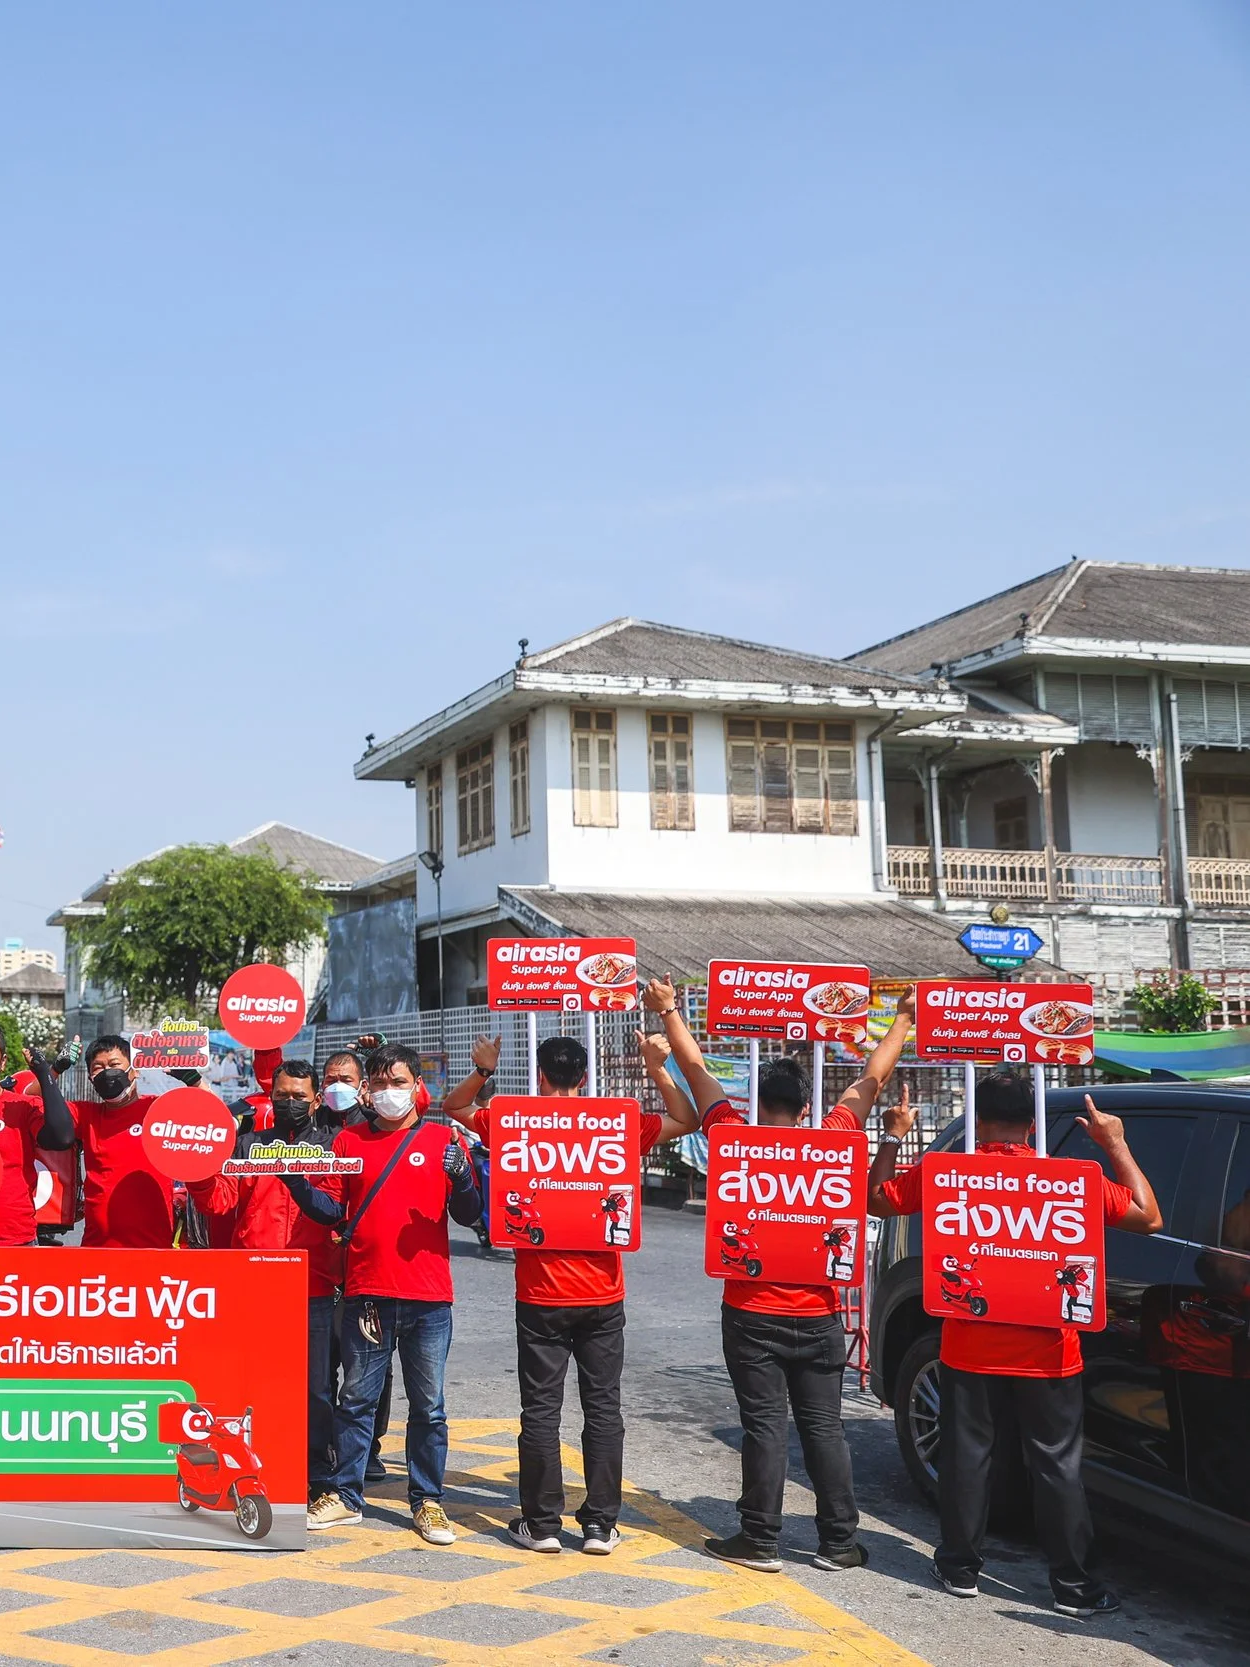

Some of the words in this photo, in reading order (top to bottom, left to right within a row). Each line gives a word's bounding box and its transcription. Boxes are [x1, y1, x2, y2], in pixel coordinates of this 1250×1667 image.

[1014, 933, 1029, 950] 21
[496, 943, 581, 962] airasia
[512, 964, 543, 975] Super
[544, 965, 567, 975] App
[719, 967, 810, 988] airasia
[502, 980, 524, 991] อิ่มคุ้ม
[553, 981, 577, 990] สั่งเลย
[227, 994, 298, 1012] airasia
[733, 989, 767, 1000] Super
[768, 991, 793, 1003] App
[927, 987, 1026, 1008] airasia
[239, 1012, 265, 1023] Super
[266, 1014, 286, 1024] App
[722, 1005, 746, 1017] อิ่มคุ้ม
[777, 1008, 803, 1018] สั่งเลย
[943, 1010, 980, 1021] Super
[982, 1011, 1009, 1023] App
[132, 1030, 208, 1048] ติดใจอาหาร
[932, 1027, 958, 1040] อิ่มคุ้ม
[992, 1029, 1021, 1040] สั่งเลย
[133, 1050, 208, 1068] ติดใจคนส่ง
[500, 1111, 572, 1129] airasia
[577, 1112, 625, 1130] food
[150, 1120, 227, 1142] airasia
[162, 1140, 190, 1151] Super
[192, 1143, 213, 1154] App
[500, 1131, 625, 1174] ส่งฟรี
[719, 1140, 795, 1160] airasia
[801, 1144, 853, 1164] food
[288, 1161, 330, 1172] airasia
[332, 1160, 361, 1172] food
[529, 1178, 538, 1189] 6
[539, 1178, 603, 1191] กิโลเมตรแรก
[718, 1161, 851, 1208] ส่งฟรี
[934, 1169, 1019, 1191] airasia
[1026, 1174, 1085, 1195] food
[748, 1209, 756, 1220] 6
[758, 1209, 826, 1225] กิโลเมตรแรก
[935, 1191, 1086, 1245] ส่งฟรี
[969, 1243, 979, 1255] 6
[981, 1243, 1058, 1262] กิโลเมตรแรก
[145, 1275, 216, 1330] ฟู้ด
[2, 1400, 147, 1454] นนทบุรี
